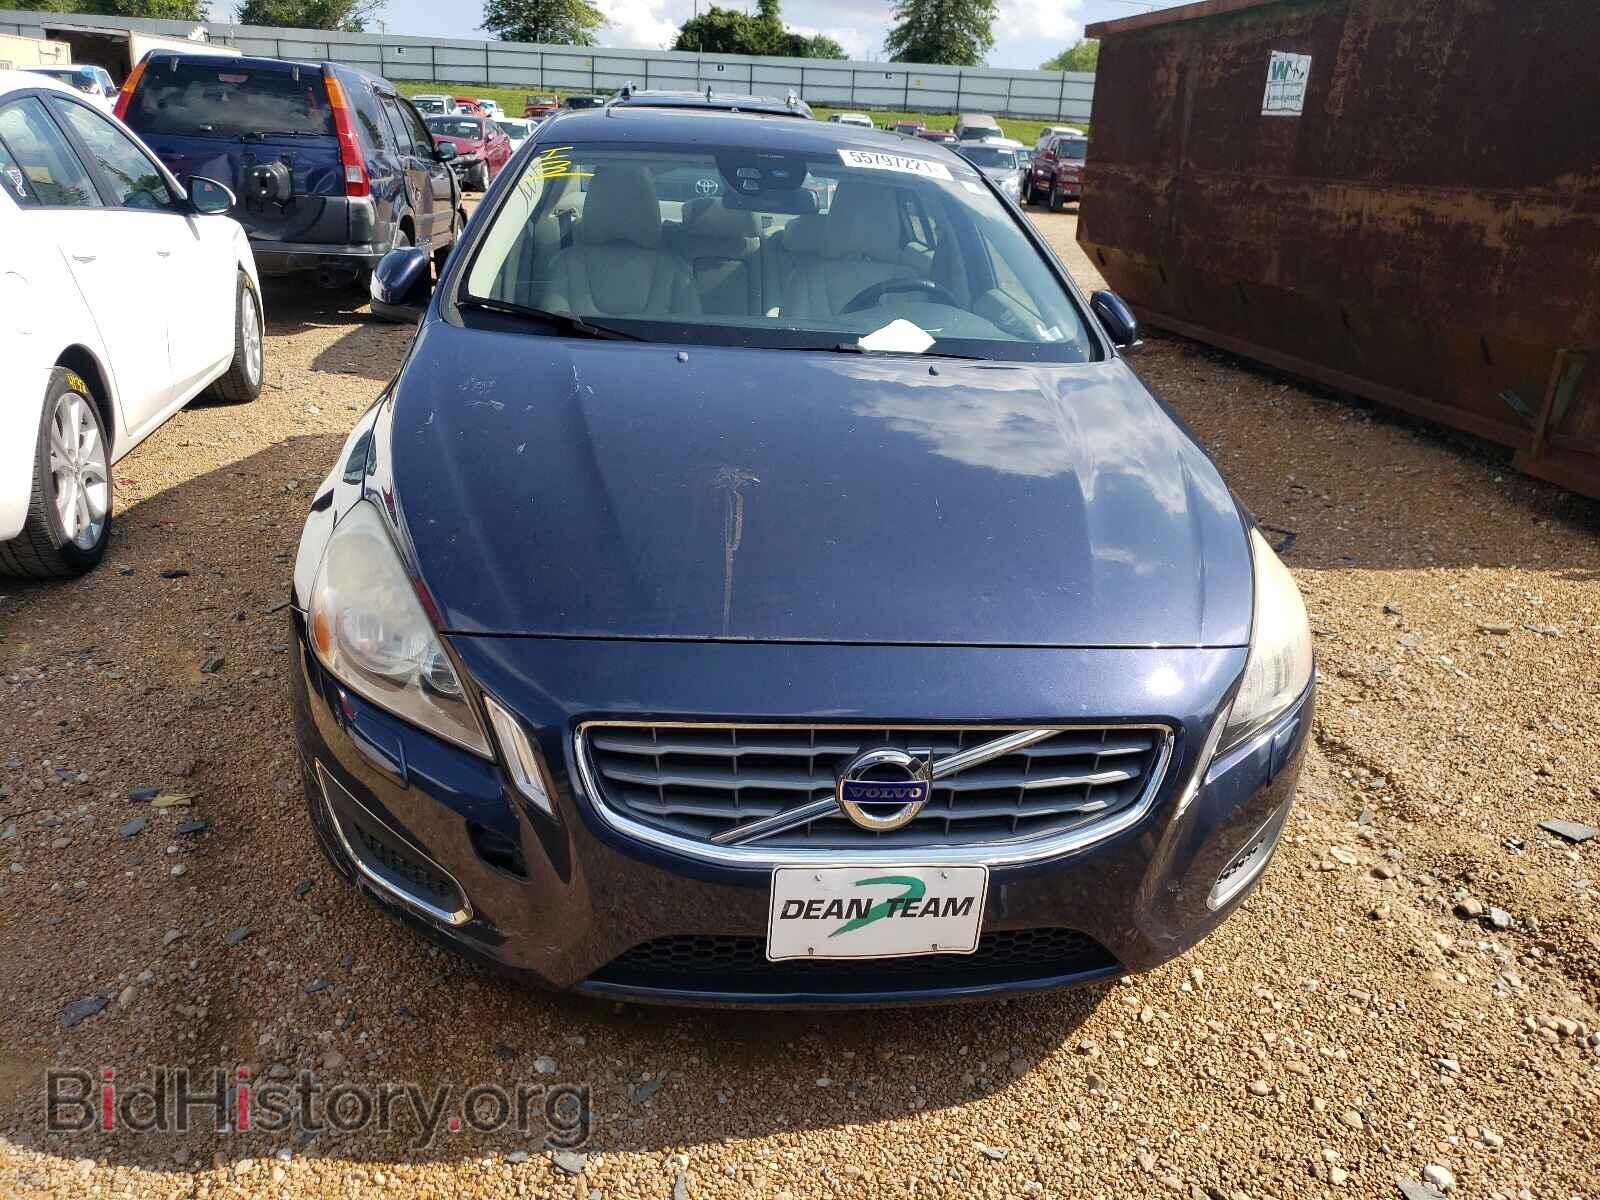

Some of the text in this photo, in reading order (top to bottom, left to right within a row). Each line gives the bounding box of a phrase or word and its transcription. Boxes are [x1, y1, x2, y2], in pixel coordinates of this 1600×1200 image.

[850, 786, 922, 799] VOLVO
[780, 897, 975, 920] DEAN TEAM
